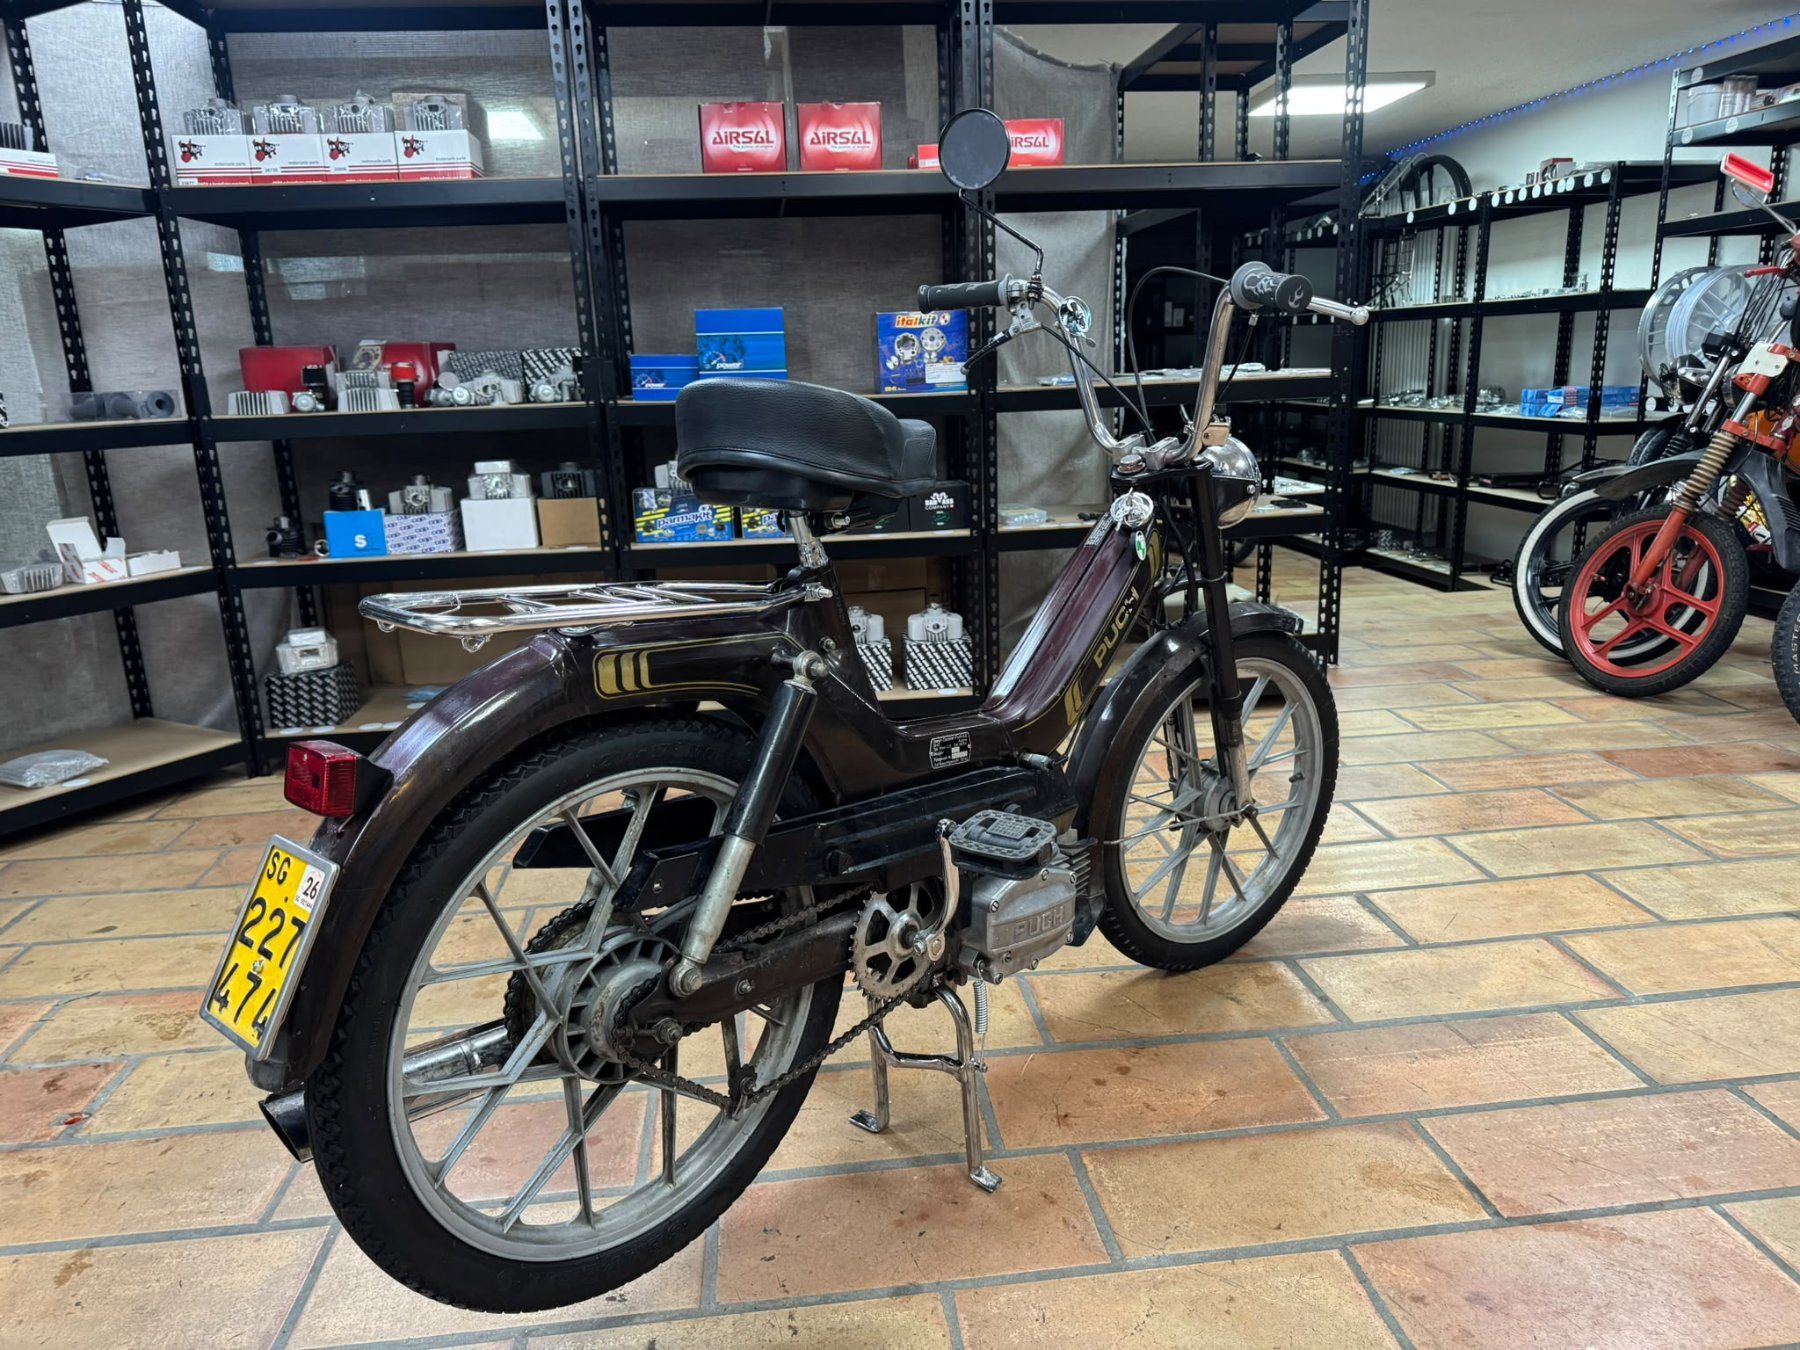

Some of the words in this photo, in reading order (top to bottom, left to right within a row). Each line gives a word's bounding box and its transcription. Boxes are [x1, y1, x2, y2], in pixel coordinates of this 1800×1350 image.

[896, 313, 938, 328] italkit
[354, 534, 368, 548] S
[266, 851, 291, 886] SG
[303, 876, 320, 900] 26
[238, 896, 307, 969] 227
[1013, 905, 1064, 940] PUCH
[214, 962, 277, 1041] 474
